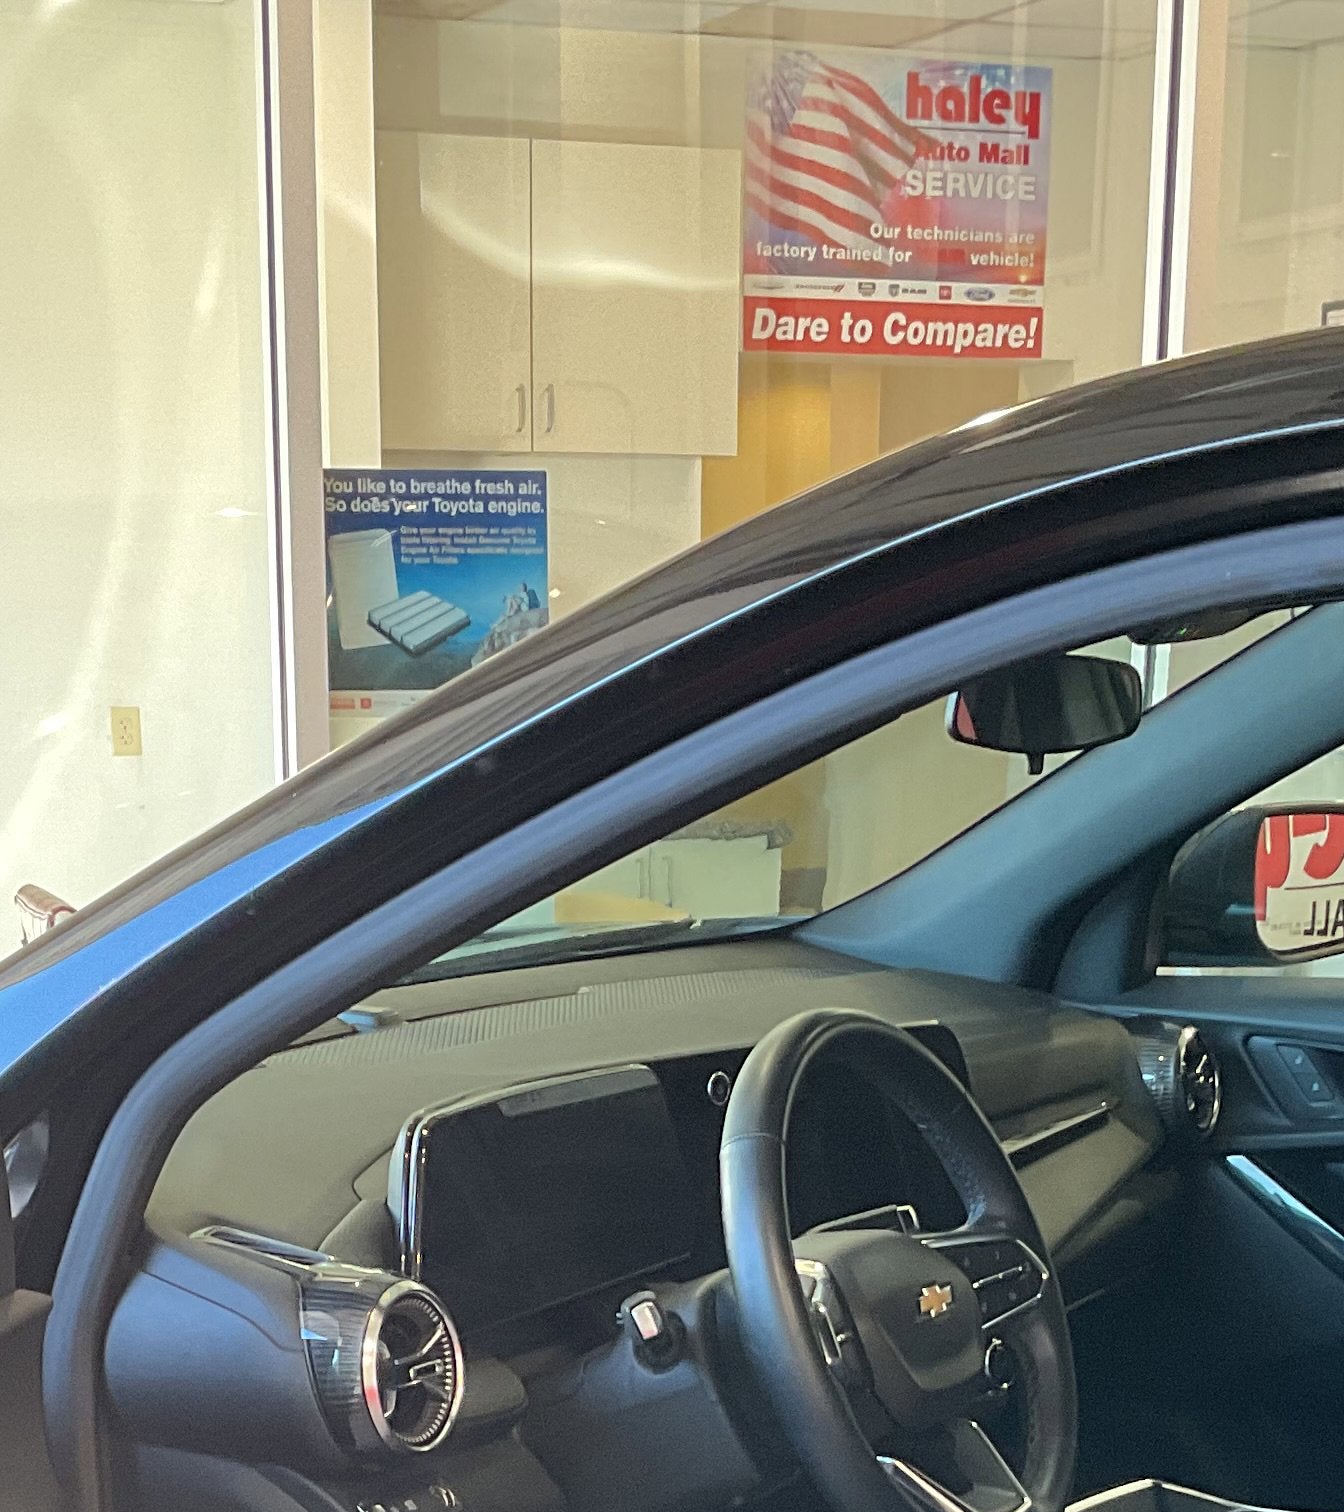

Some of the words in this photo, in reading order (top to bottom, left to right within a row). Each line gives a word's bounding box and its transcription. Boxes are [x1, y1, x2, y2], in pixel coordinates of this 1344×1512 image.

[906, 71, 1041, 140] haley
[915, 142, 970, 162] Auto
[979, 143, 1030, 165] Mall
[905, 170, 1037, 201] SERVICE
[870, 223, 901, 239] Our
[907, 224, 1003, 243] technicians
[1008, 232, 1035, 244] are
[756, 242, 817, 261] factory
[822, 244, 882, 261] trained
[888, 246, 913, 264] for
[970, 251, 1034, 268] vehicle!
[752, 307, 829, 342] Dare
[841, 311, 873, 344] to
[883, 311, 1038, 354] Compare!
[324, 478, 353, 494] You
[357, 478, 386, 494] like
[389, 478, 406, 494] to
[410, 478, 471, 494] breathe
[475, 479, 514, 495] fresh
[518, 480, 542, 495] air.
[325, 497, 347, 512] So
[350, 497, 390, 513] does
[391, 498, 429, 516] your
[431, 497, 484, 516] Toyota
[488, 498, 545, 516] engine.
